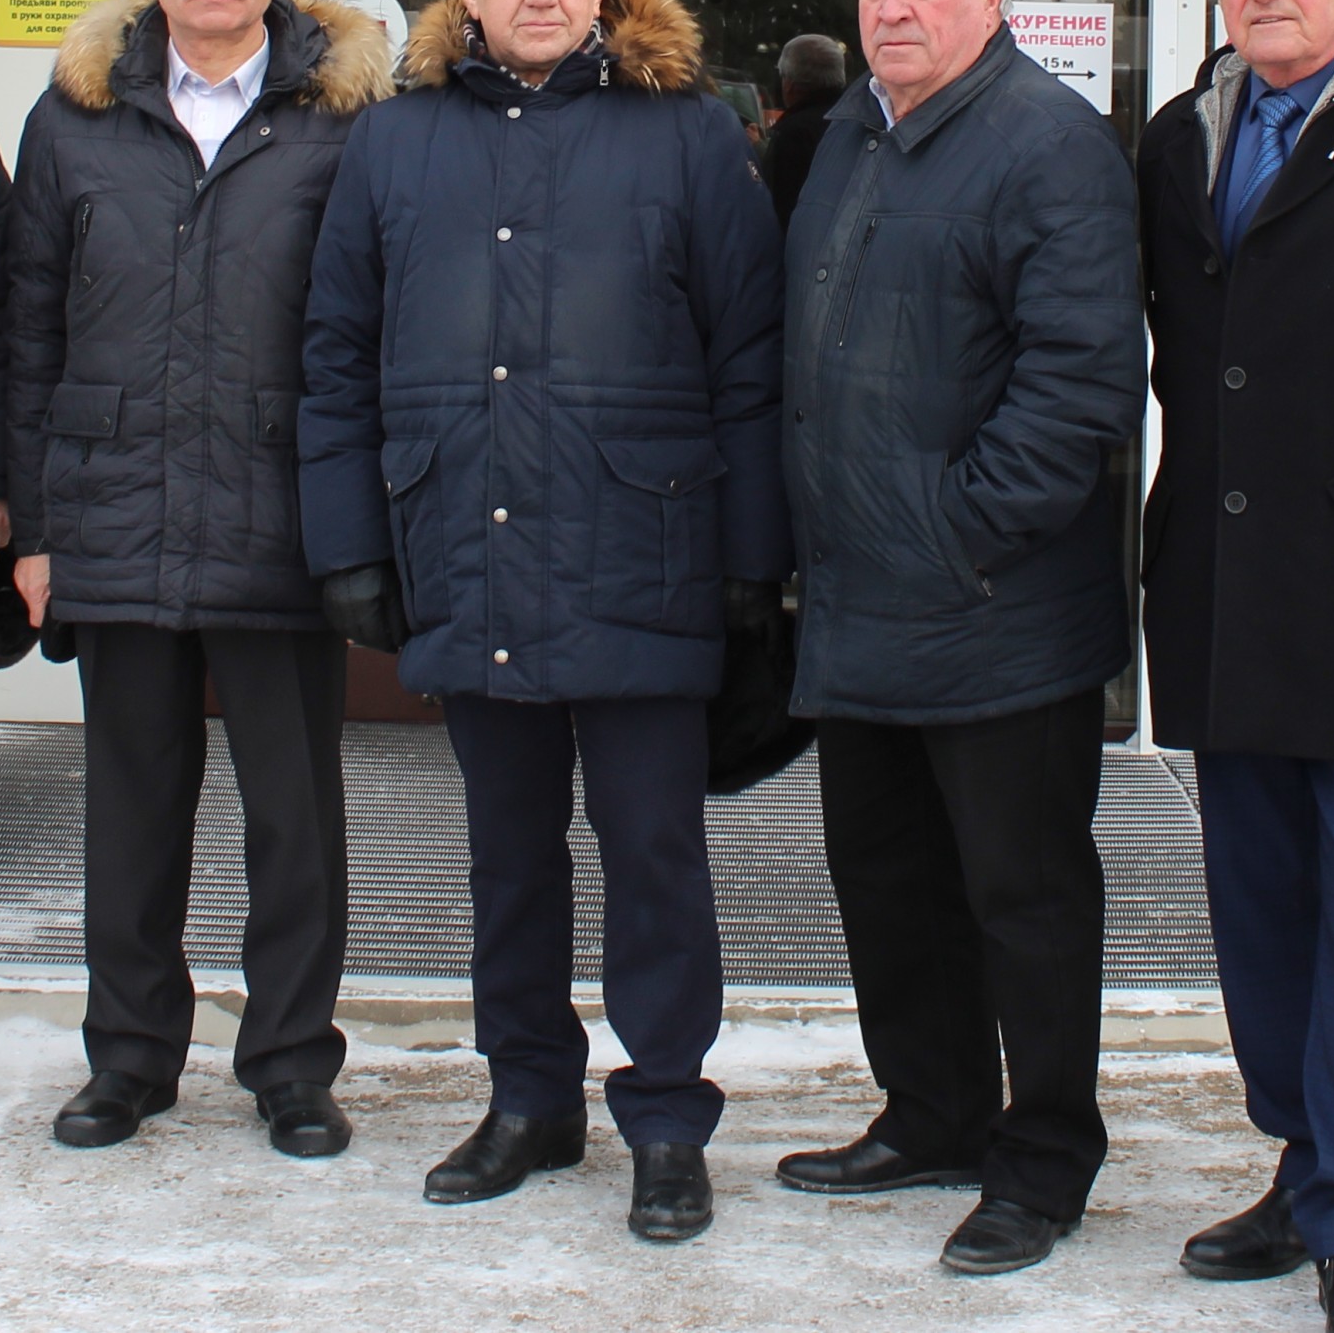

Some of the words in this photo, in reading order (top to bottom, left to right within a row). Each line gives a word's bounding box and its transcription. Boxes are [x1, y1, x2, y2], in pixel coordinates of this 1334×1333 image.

[59, 0, 91, 9] пропу
[19, 11, 43, 21] руки
[44, 12, 80, 21] охранн
[1008, 14, 1108, 30] КУРЕНИЕ
[25, 24, 44, 33] для
[1040, 57, 1060, 69] 15
[1062, 60, 1075, 69] м
